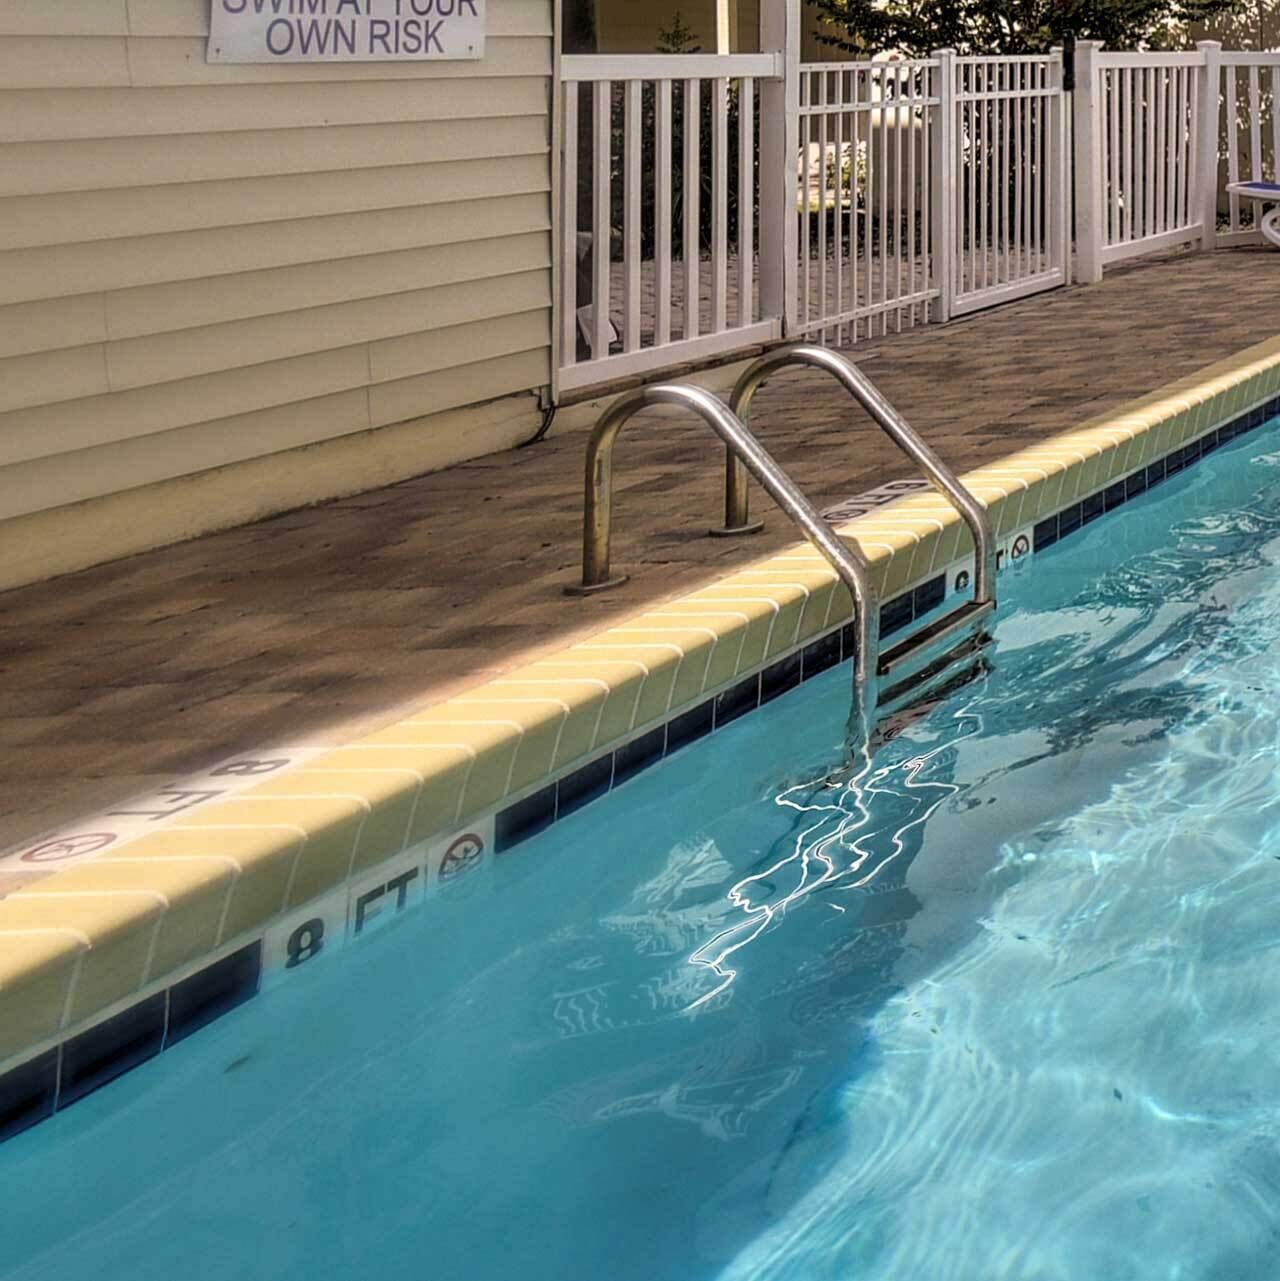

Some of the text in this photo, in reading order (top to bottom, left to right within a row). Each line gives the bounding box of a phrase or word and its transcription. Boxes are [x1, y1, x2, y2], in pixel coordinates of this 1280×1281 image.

[266, 18, 445, 55] OWN RISK
[106, 759, 291, 822] 8 FT
[354, 866, 419, 934] FT
